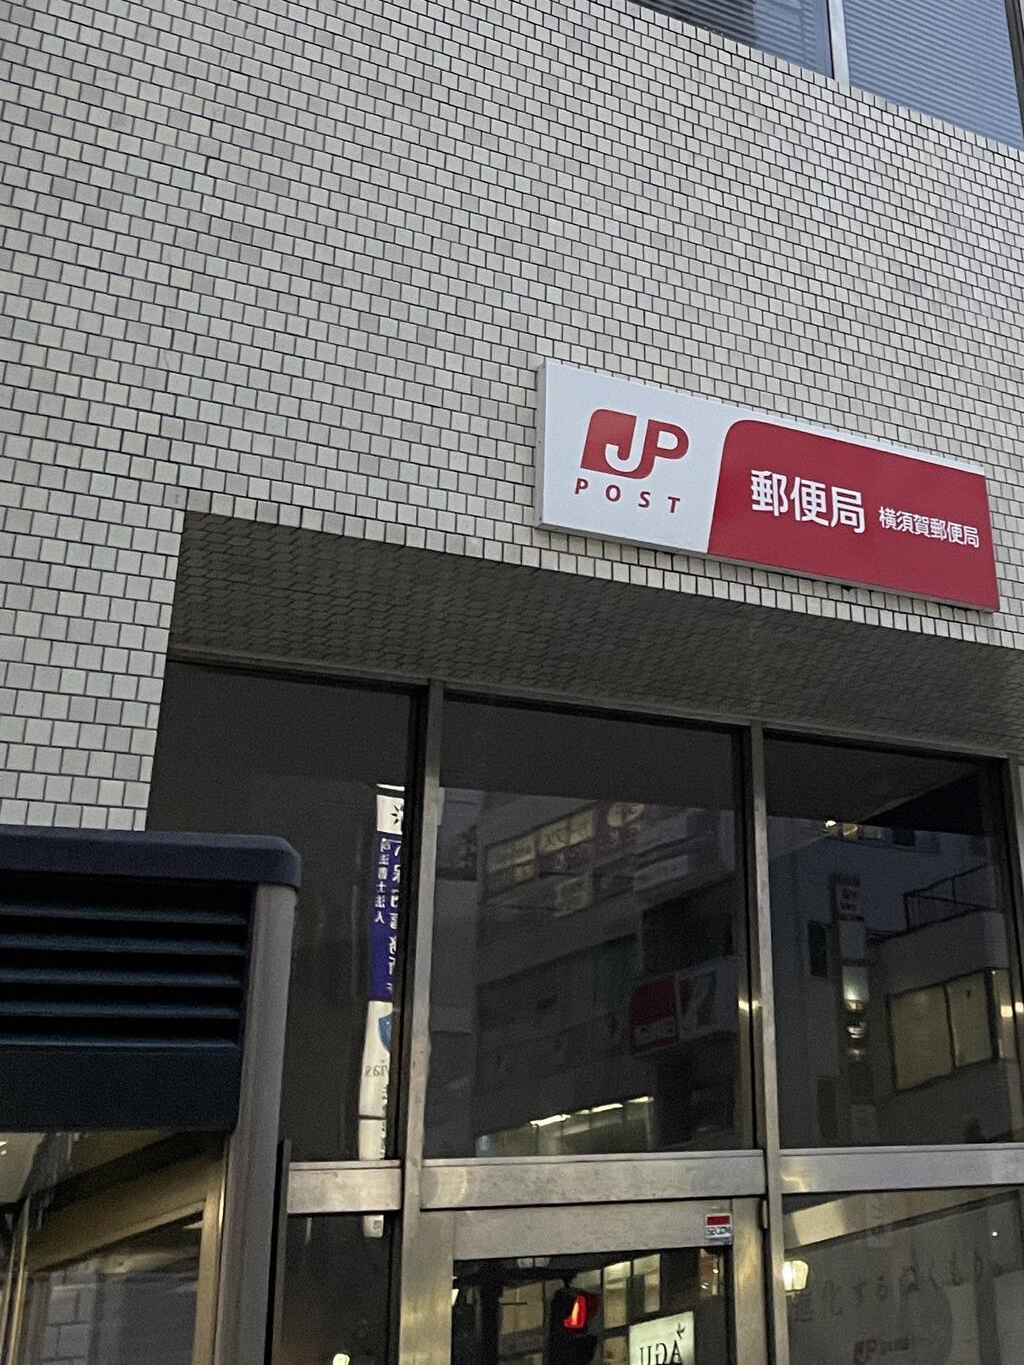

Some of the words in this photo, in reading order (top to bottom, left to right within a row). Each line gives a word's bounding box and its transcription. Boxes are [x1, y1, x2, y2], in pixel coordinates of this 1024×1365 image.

[581, 409, 689, 479] JP
[575, 478, 681, 514] POST
[750, 469, 866, 534] 郵便局
[878, 506, 981, 549] 横須賀郵便局
